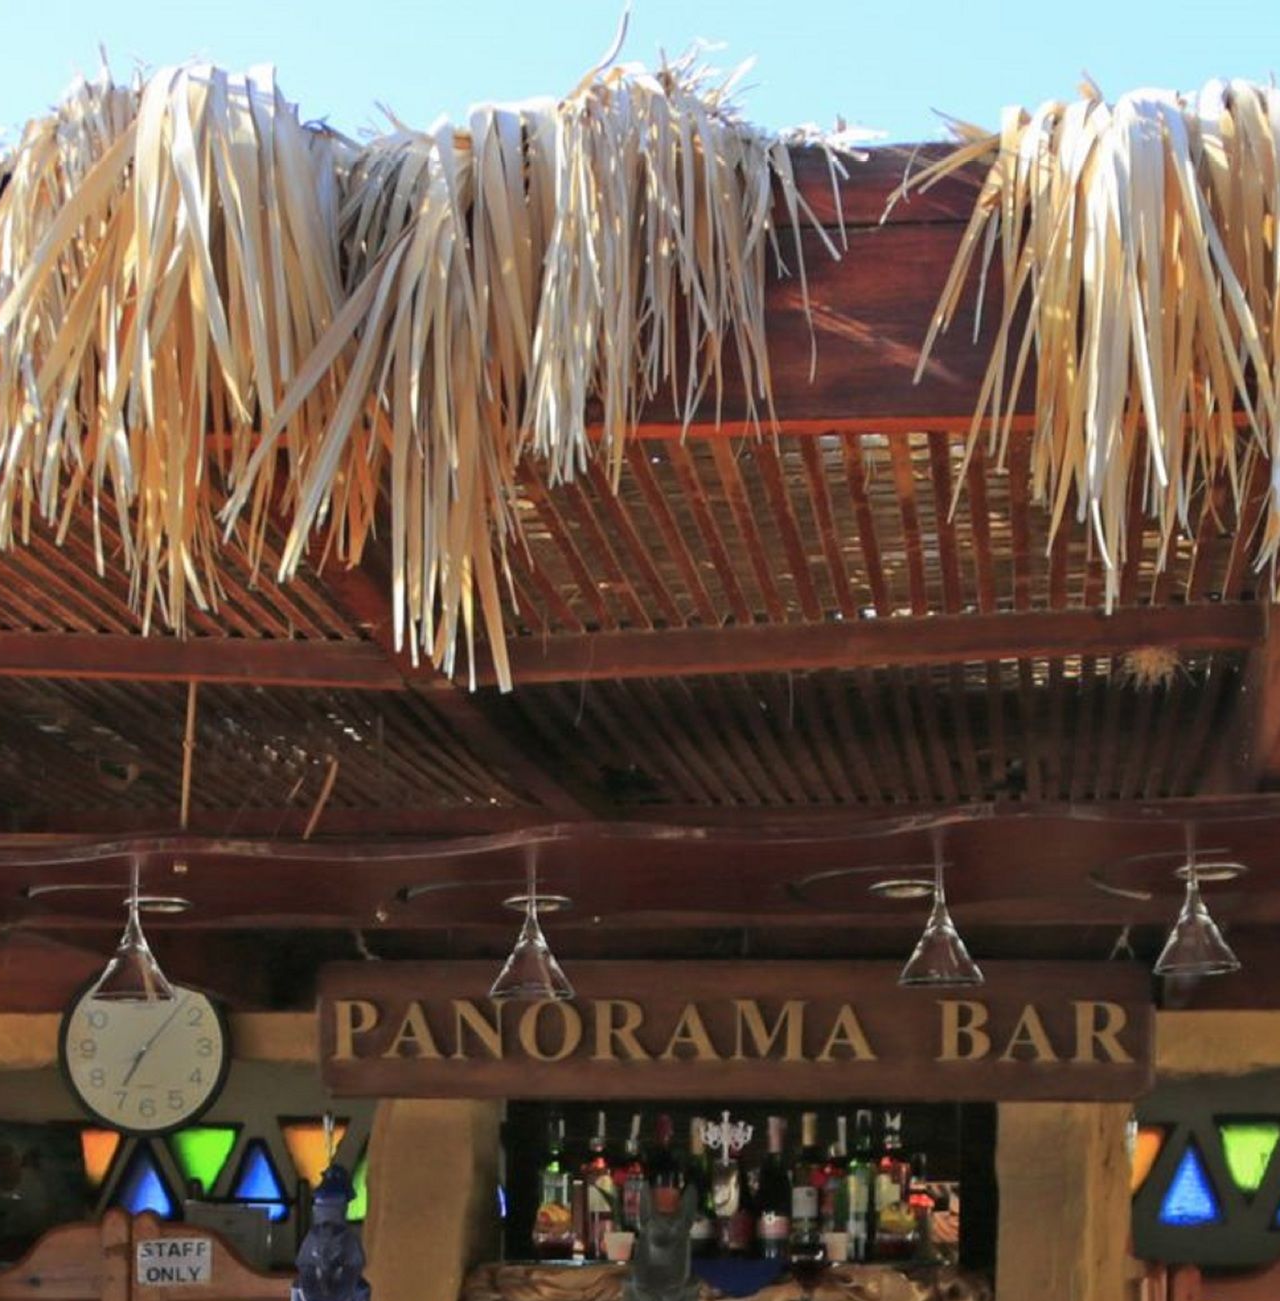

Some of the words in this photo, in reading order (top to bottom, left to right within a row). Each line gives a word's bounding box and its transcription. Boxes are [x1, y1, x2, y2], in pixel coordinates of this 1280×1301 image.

[187, 1007, 203, 1027] 2
[330, 998, 878, 1063] PANORAMA
[934, 999, 1135, 1064] BAR
[79, 1039, 96, 1060] 9
[196, 1037, 213, 1057] 3
[89, 1068, 105, 1088] 8
[189, 1067, 202, 1086] 4
[113, 1090, 128, 1110] 7
[139, 1098, 156, 1118] 6
[167, 1089, 183, 1110] 5
[141, 1242, 207, 1257] STAFF
[146, 1266, 202, 1282] ONLY
